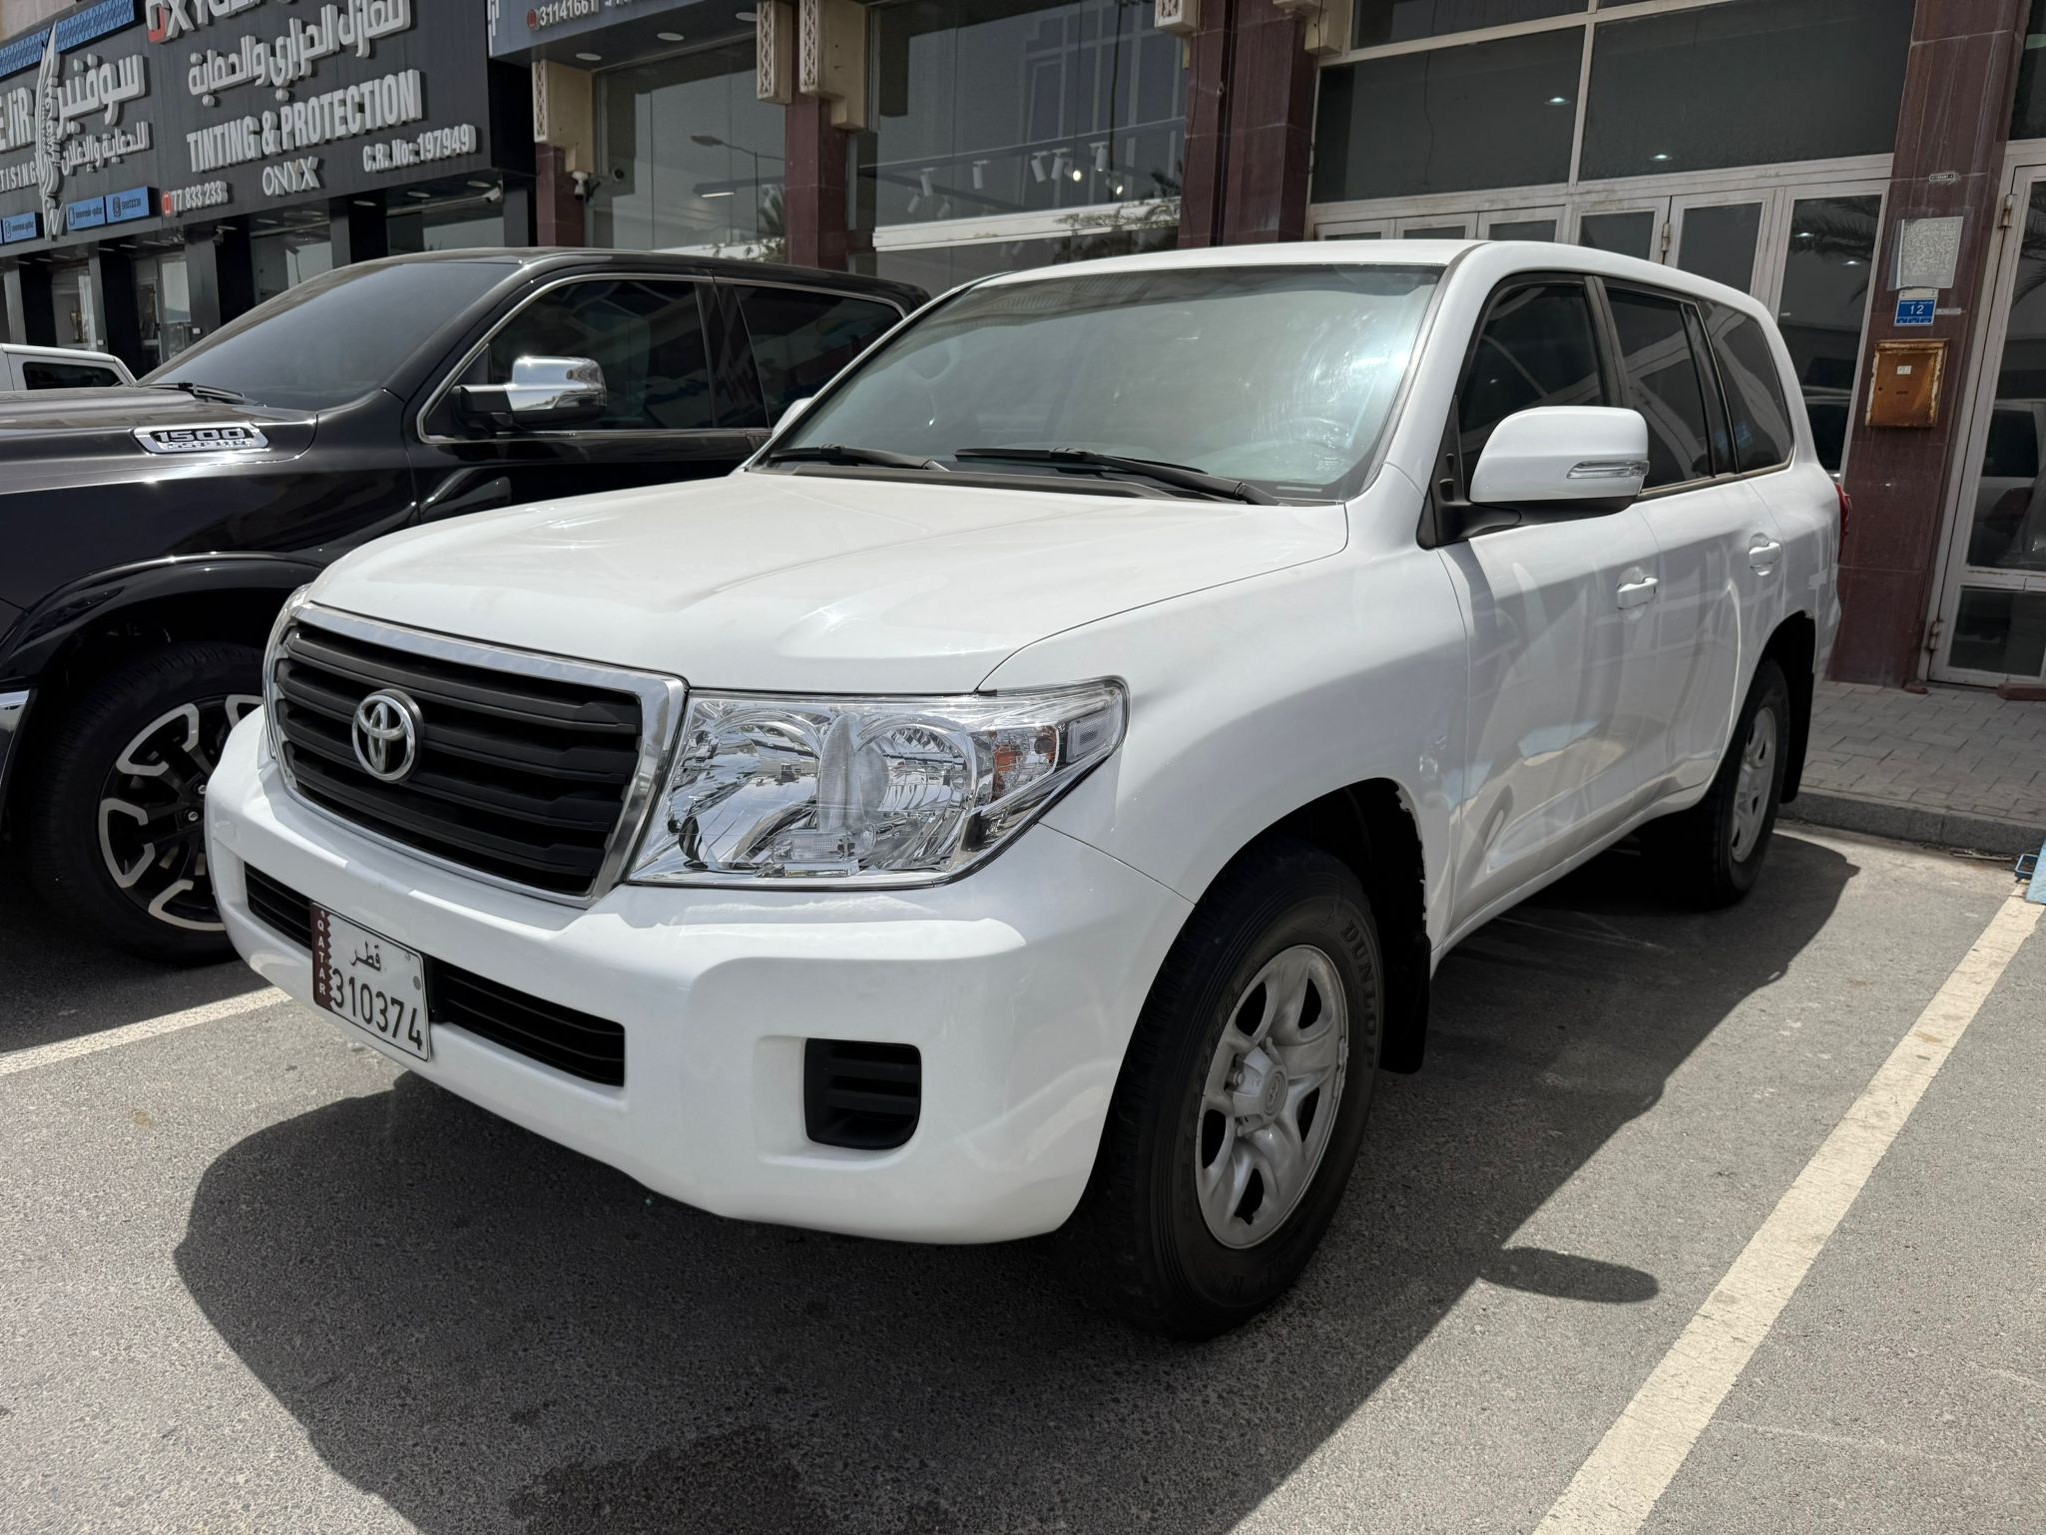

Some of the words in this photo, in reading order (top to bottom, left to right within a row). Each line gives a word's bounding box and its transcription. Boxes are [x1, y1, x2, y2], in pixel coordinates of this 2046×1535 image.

[540, 0, 596, 26] 31141661
[188, 35, 270, 107] والحماية
[269, 3, 338, 101] الحراري
[56, 53, 145, 140] سوفنير
[186, 116, 262, 172] TINTING
[262, 110, 281, 155] &
[280, 69, 422, 150] PROTECTION
[417, 124, 473, 160] 197949
[102, 121, 149, 164] للدعاية
[171, 189, 183, 211] 77
[185, 184, 202, 209] 833
[204, 180, 223, 205] 233
[262, 156, 320, 196] ONYX
[1910, 304, 1924, 314] 12
[156, 428, 245, 442] 1500
[317, 919, 327, 996] QATAR
[350, 941, 381, 972] قطر
[332, 968, 423, 1051] 310374
[1341, 919, 1376, 1069] DUNLOP
